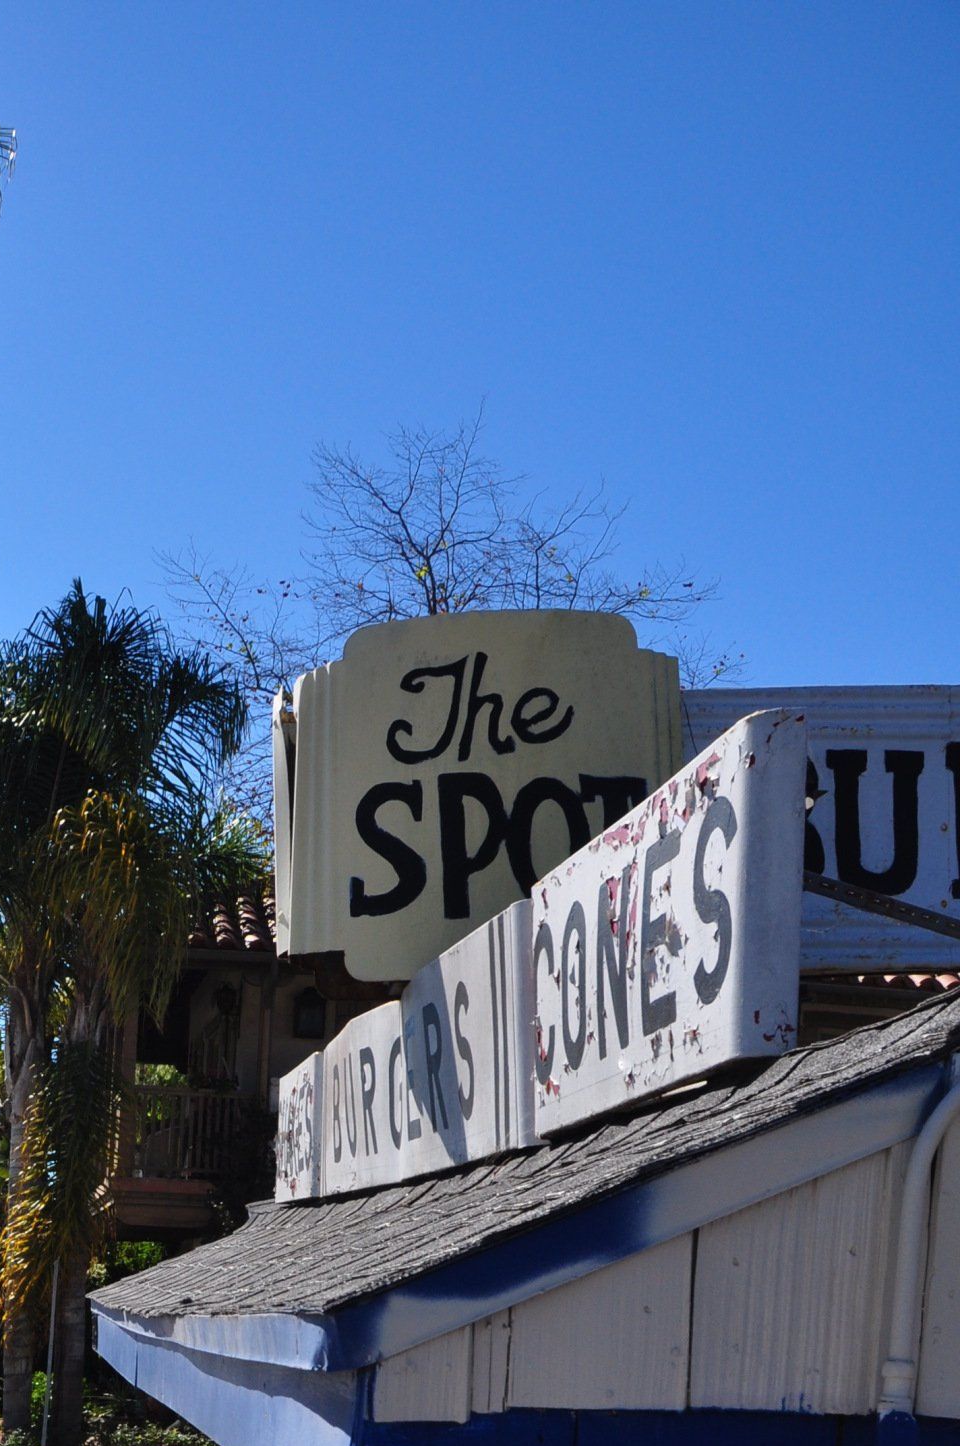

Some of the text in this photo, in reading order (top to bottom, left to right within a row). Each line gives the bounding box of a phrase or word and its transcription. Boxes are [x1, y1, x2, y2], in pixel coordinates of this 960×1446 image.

[385, 651, 575, 765] The
[533, 795, 738, 1086] CONES
[333, 981, 475, 1164] BURGERS
